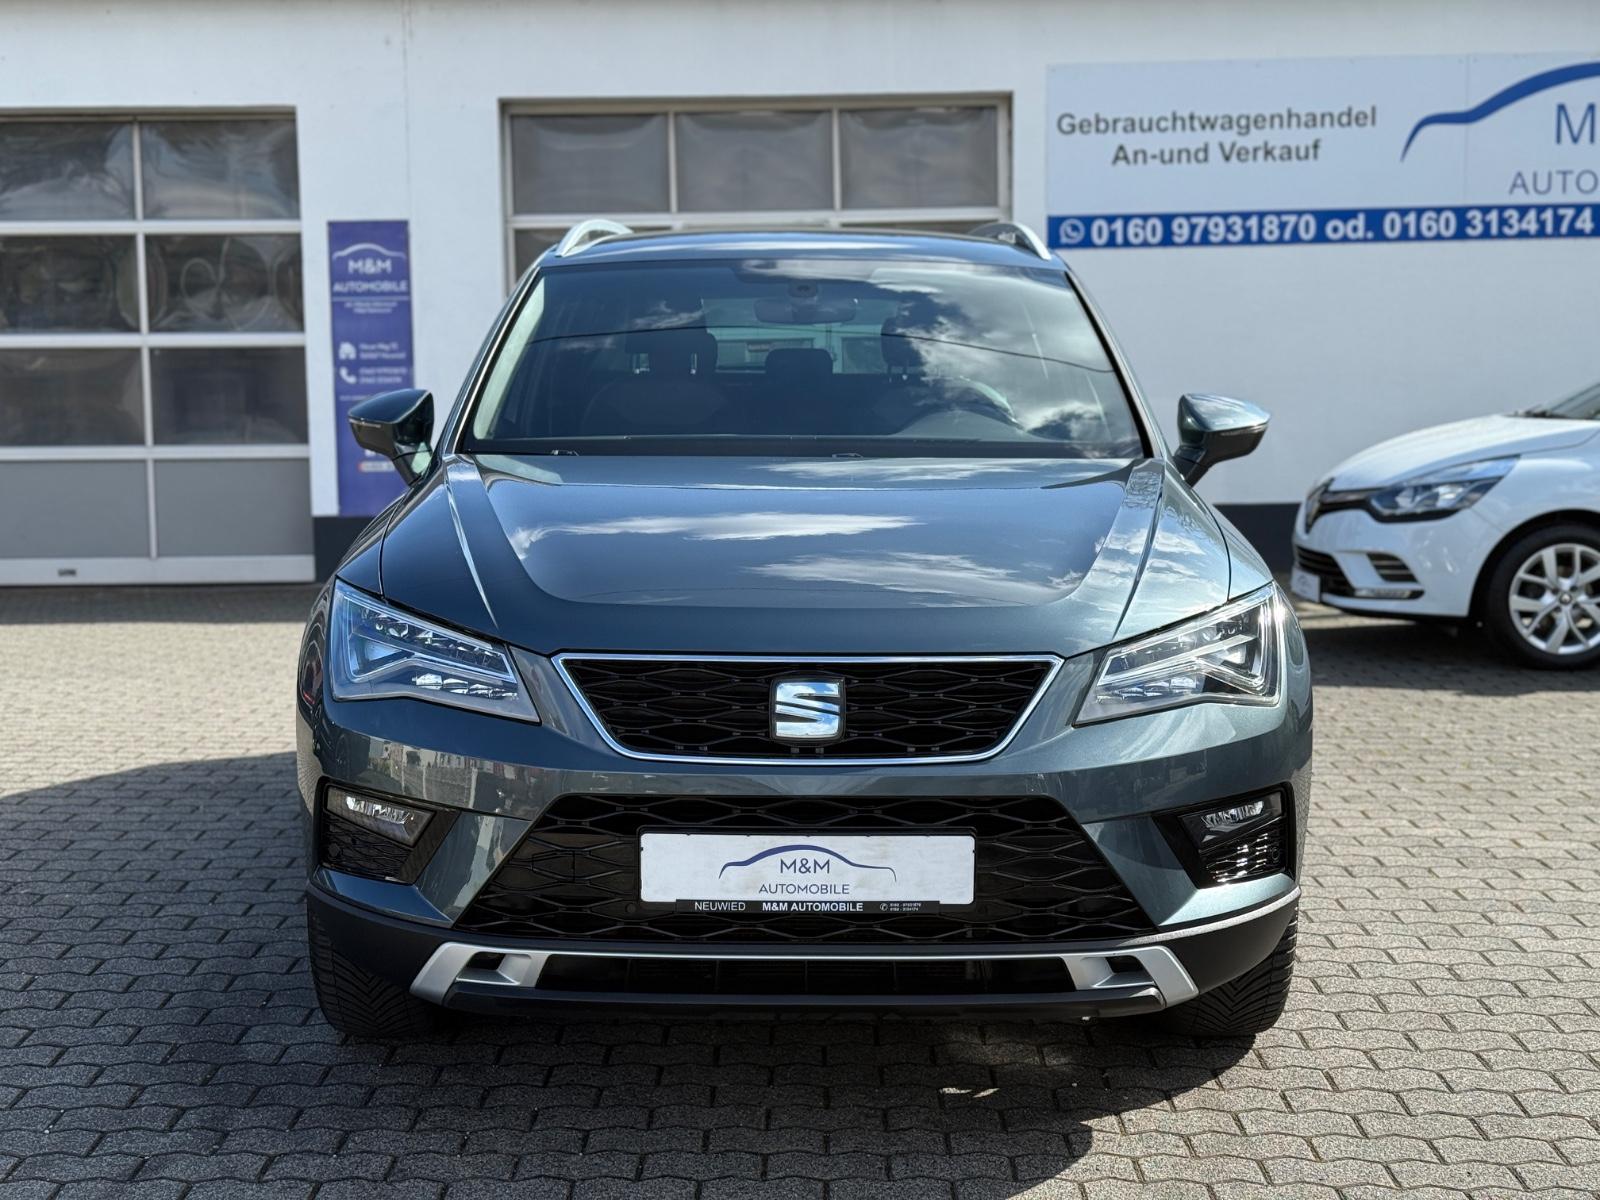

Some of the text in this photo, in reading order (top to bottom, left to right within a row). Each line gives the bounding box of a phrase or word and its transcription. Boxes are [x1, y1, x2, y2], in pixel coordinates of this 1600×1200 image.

[1056, 105, 1377, 136] Gebrauchtwagenhandel
[1111, 138, 1322, 167] An-und Verkauf
[1089, 207, 1595, 246] 0160 97931870 od. 0160 3134174
[347, 258, 393, 275] M&M
[332, 280, 409, 293] AUTOMOBILE
[780, 857, 831, 875] M&M
[758, 883, 851, 895] AUTOMOBILE
[694, 901, 864, 912] NEUWIED M&M AUTOMOBILE
